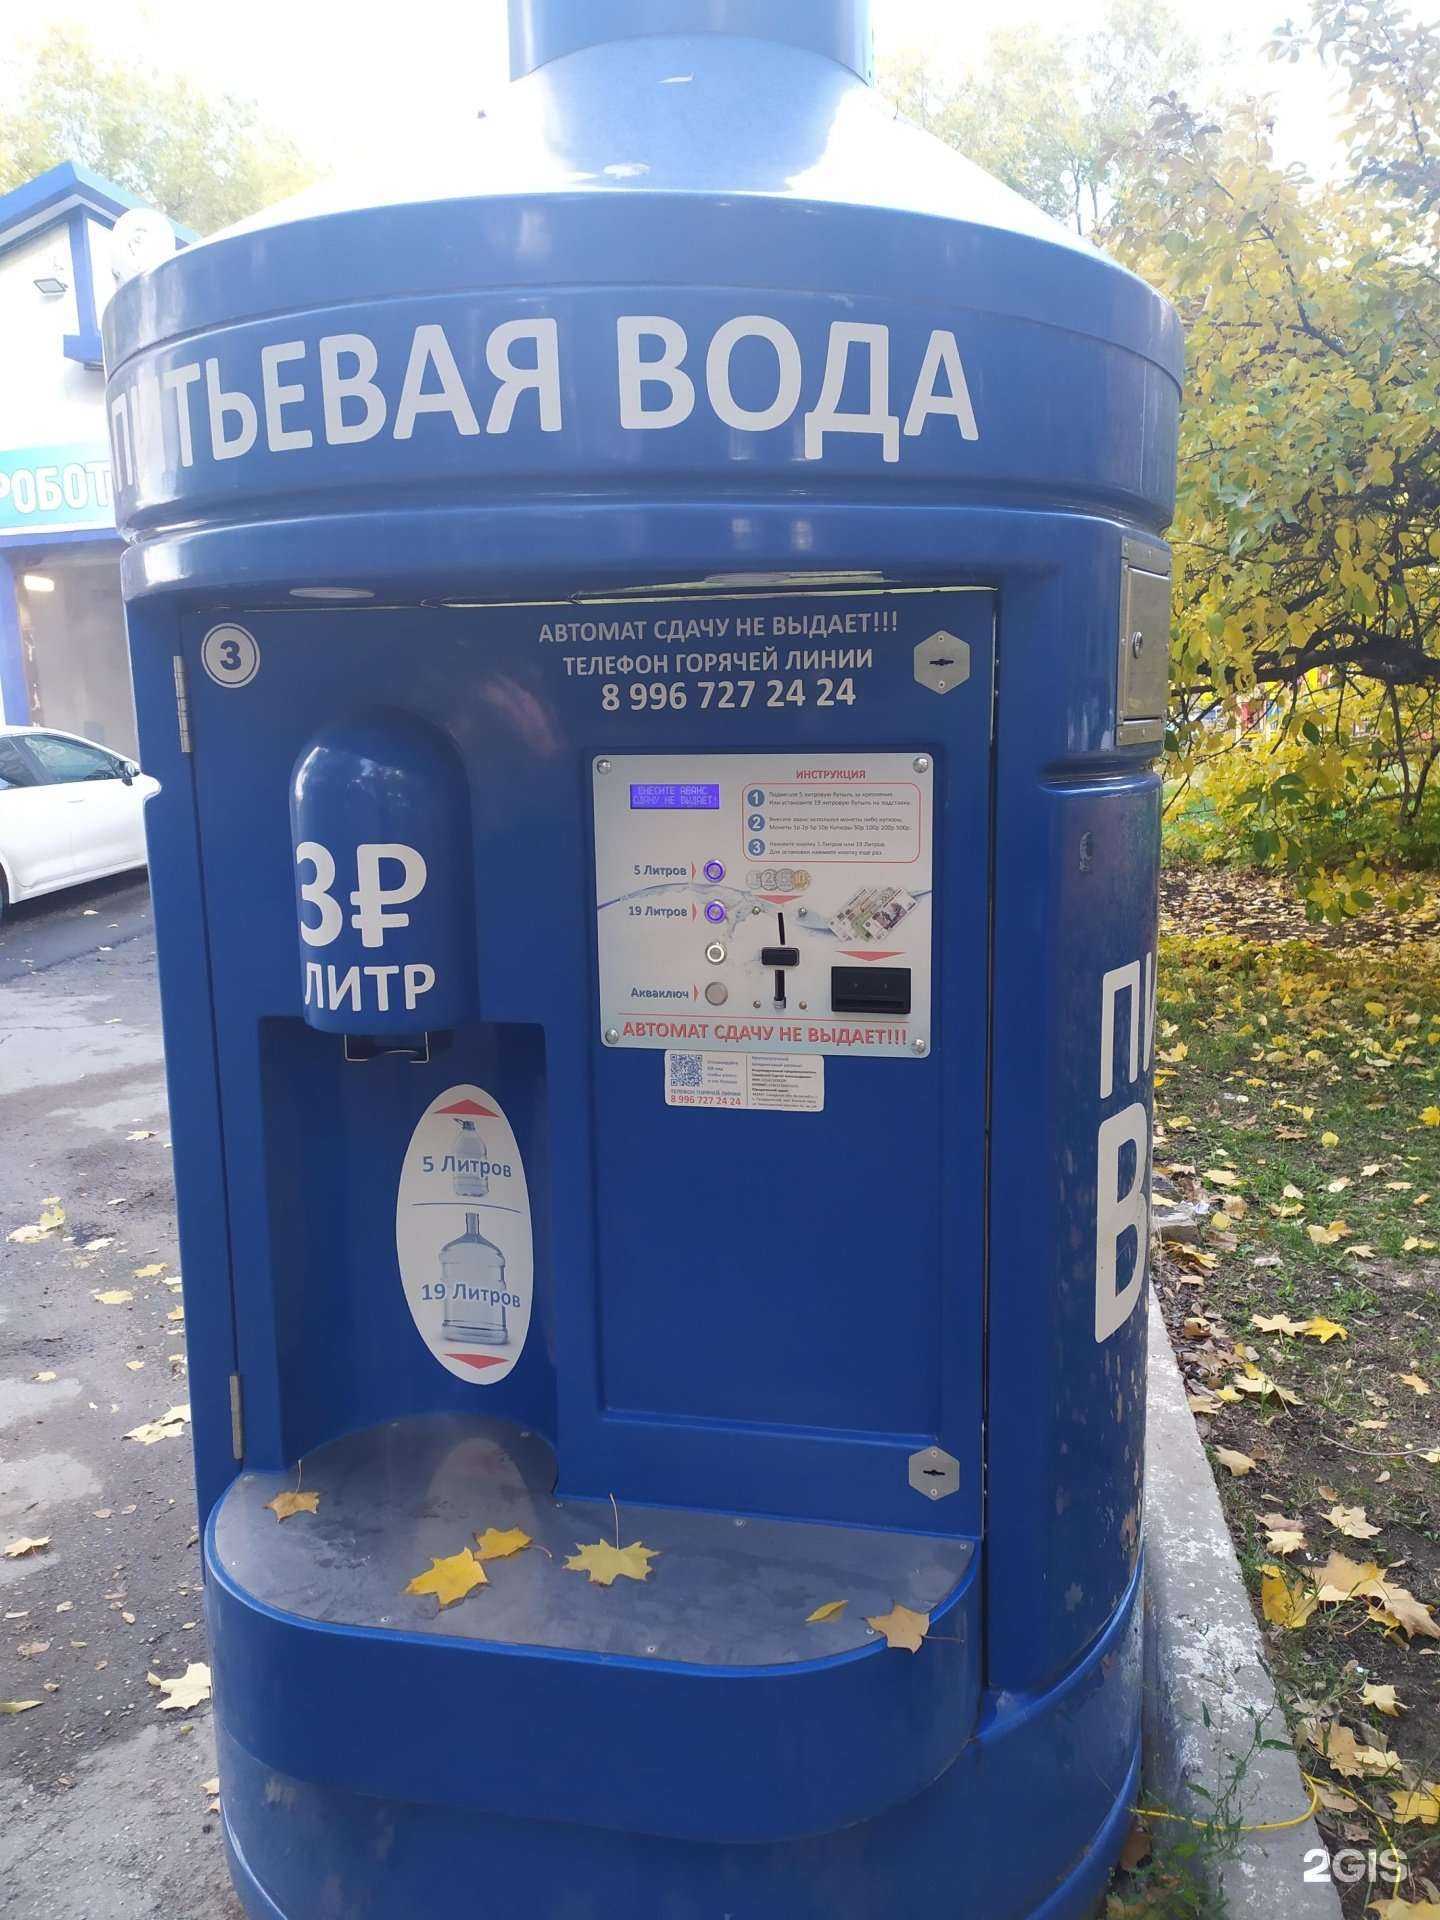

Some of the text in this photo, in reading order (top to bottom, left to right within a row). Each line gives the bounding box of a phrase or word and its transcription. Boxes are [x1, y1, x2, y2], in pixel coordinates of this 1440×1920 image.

[616, 314, 979, 463] ВОДА
[539, 611, 898, 643] АВТОМАТ СДАЧУ НЕ ВЫДАЕТ!!!
[220, 640, 241, 670] 3
[563, 647, 873, 676] ТЕЛЕФОН ГОРЯЧЕЙ ЛИНИИ
[601, 678, 857, 711] 8 996 727 24 24
[796, 770, 866, 780] ИНСТРУКЦИЯ
[752, 790, 760, 805] 1
[752, 816, 761, 829] 2
[753, 841, 761, 854] 3
[634, 864, 687, 878] 5 Литров
[628, 906, 688, 919] 19 Литров
[304, 962, 436, 1012] ЛИТР
[630, 987, 689, 999] Акваключ
[622, 1021, 907, 1047] АВТОМАТ СДАЧУ НЕ ВЫДАЕТ!!!
[422, 1155, 512, 1179] 5 Литров
[421, 1283, 521, 1309] 19 Литров
